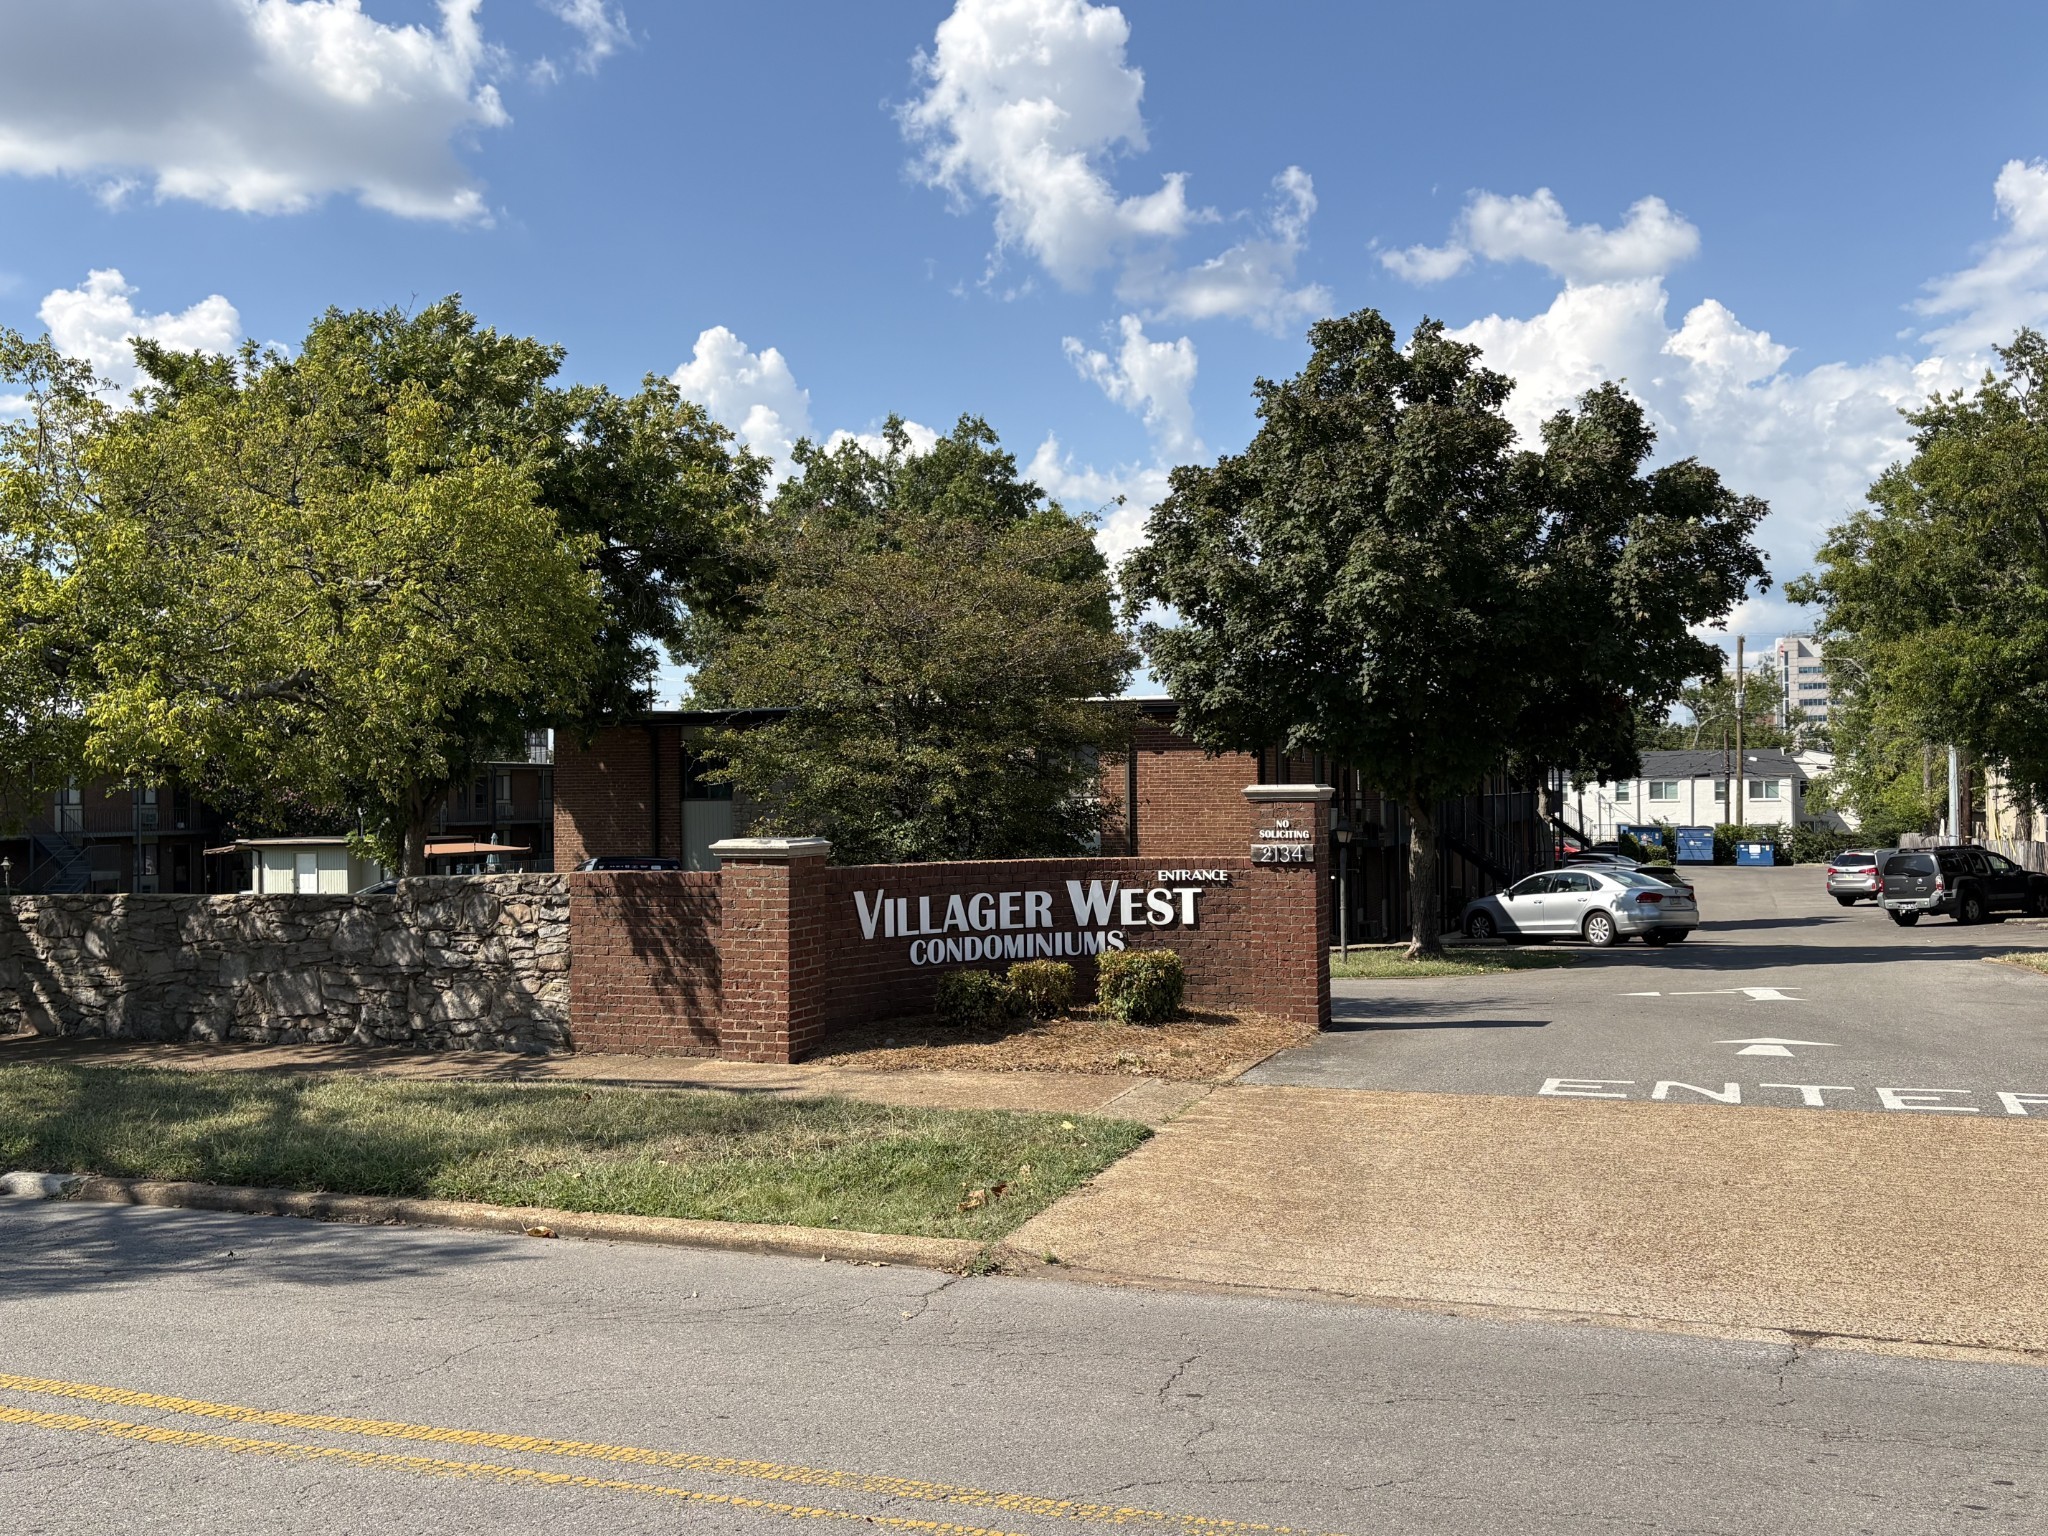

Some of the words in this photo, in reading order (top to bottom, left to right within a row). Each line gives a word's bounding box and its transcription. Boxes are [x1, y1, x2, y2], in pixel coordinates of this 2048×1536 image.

[1275, 819, 1289, 828] NO
[1259, 829, 1309, 839] SOLICITING
[1260, 845, 1303, 862] 2134
[1158, 869, 1228, 881] ENTRANCE
[853, 889, 1053, 940] VILLAGER
[1066, 879, 1202, 926] WEST
[909, 930, 1125, 966] CONDOMINIUMS
